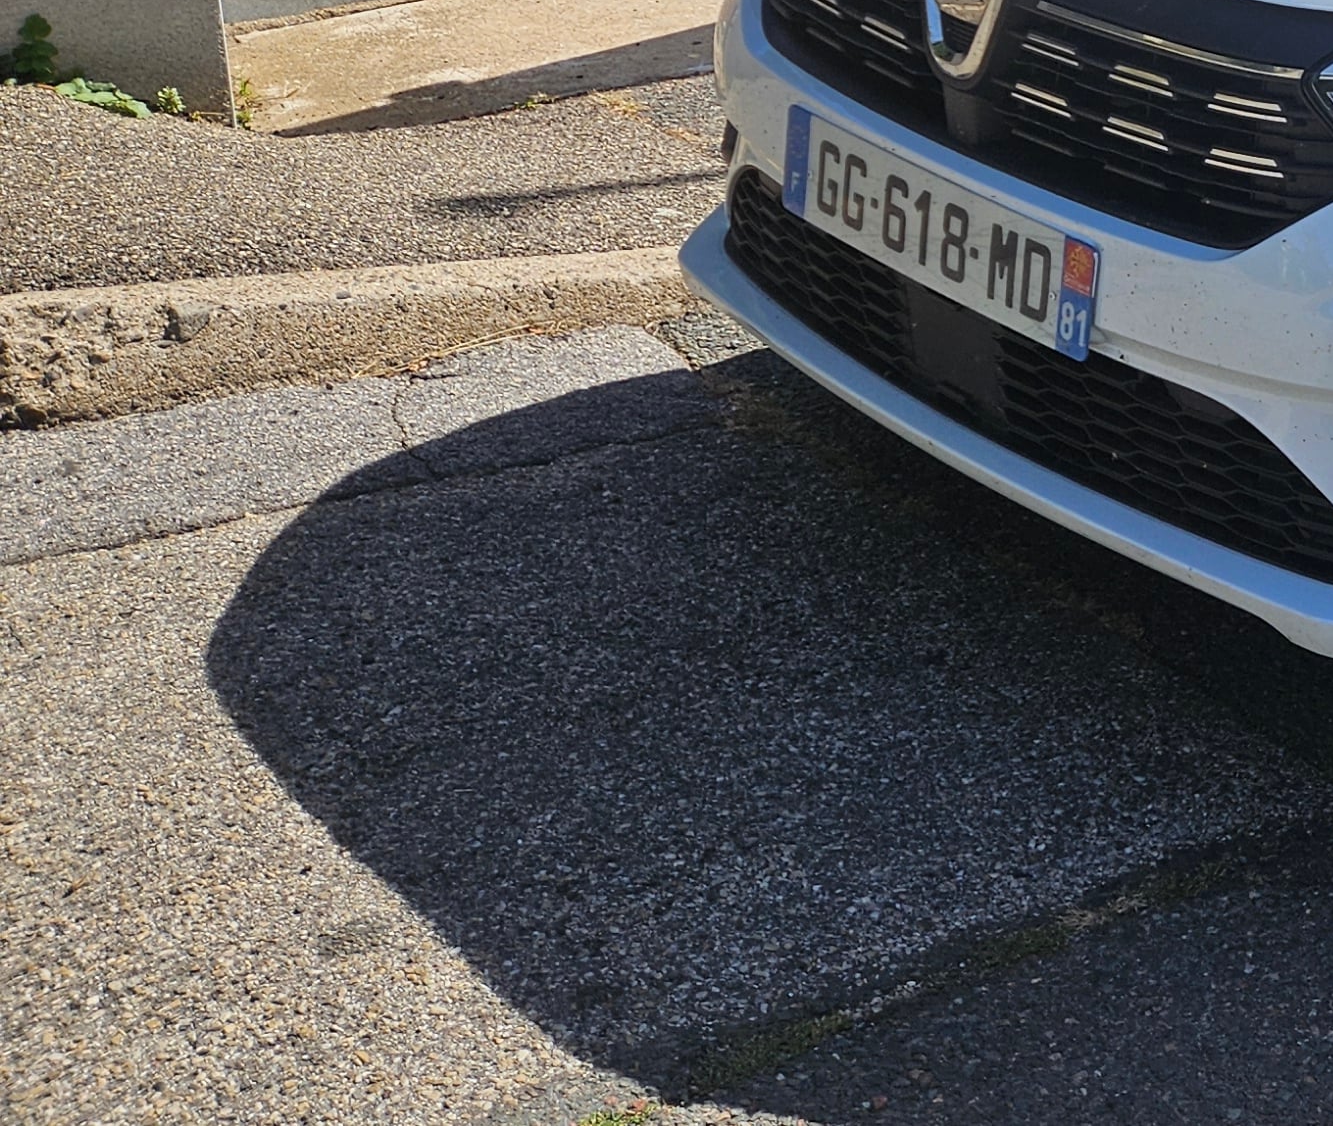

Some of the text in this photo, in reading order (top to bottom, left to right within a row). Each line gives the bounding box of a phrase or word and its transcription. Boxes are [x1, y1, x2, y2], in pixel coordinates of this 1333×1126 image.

[791, 171, 801, 193] F
[816, 139, 1051, 323] GG-618-MD
[1059, 302, 1088, 347] 81
